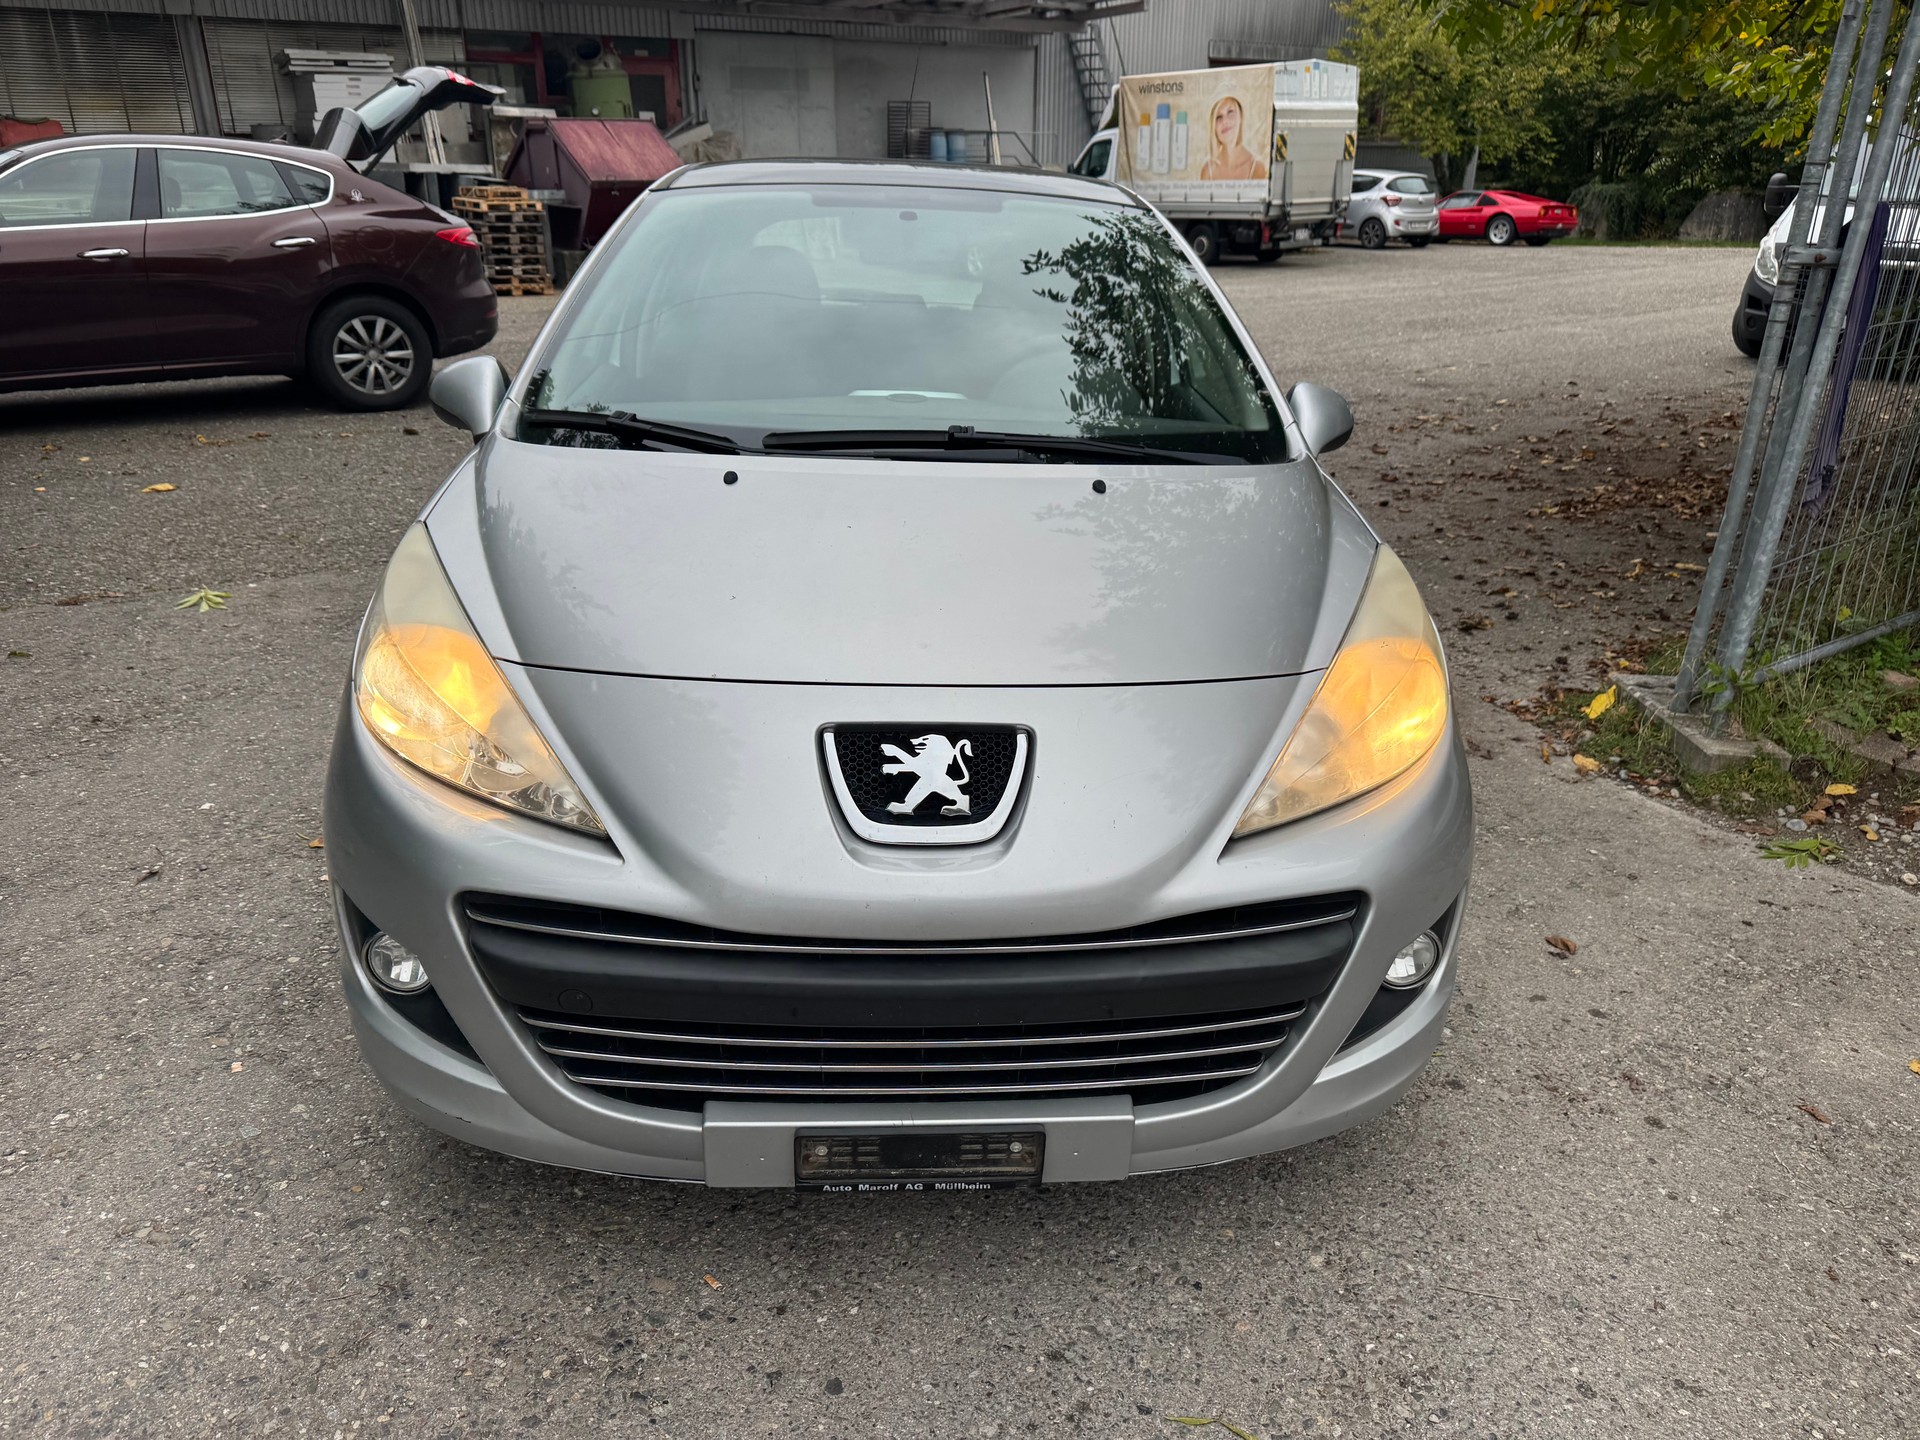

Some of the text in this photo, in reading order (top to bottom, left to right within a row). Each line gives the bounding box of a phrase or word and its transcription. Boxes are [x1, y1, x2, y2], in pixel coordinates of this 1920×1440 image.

[1138, 80, 1184, 94] winstons
[858, 1183, 899, 1191] Marolf
[904, 1183, 924, 1191] AG
[934, 1182, 991, 1190] Müllheim
